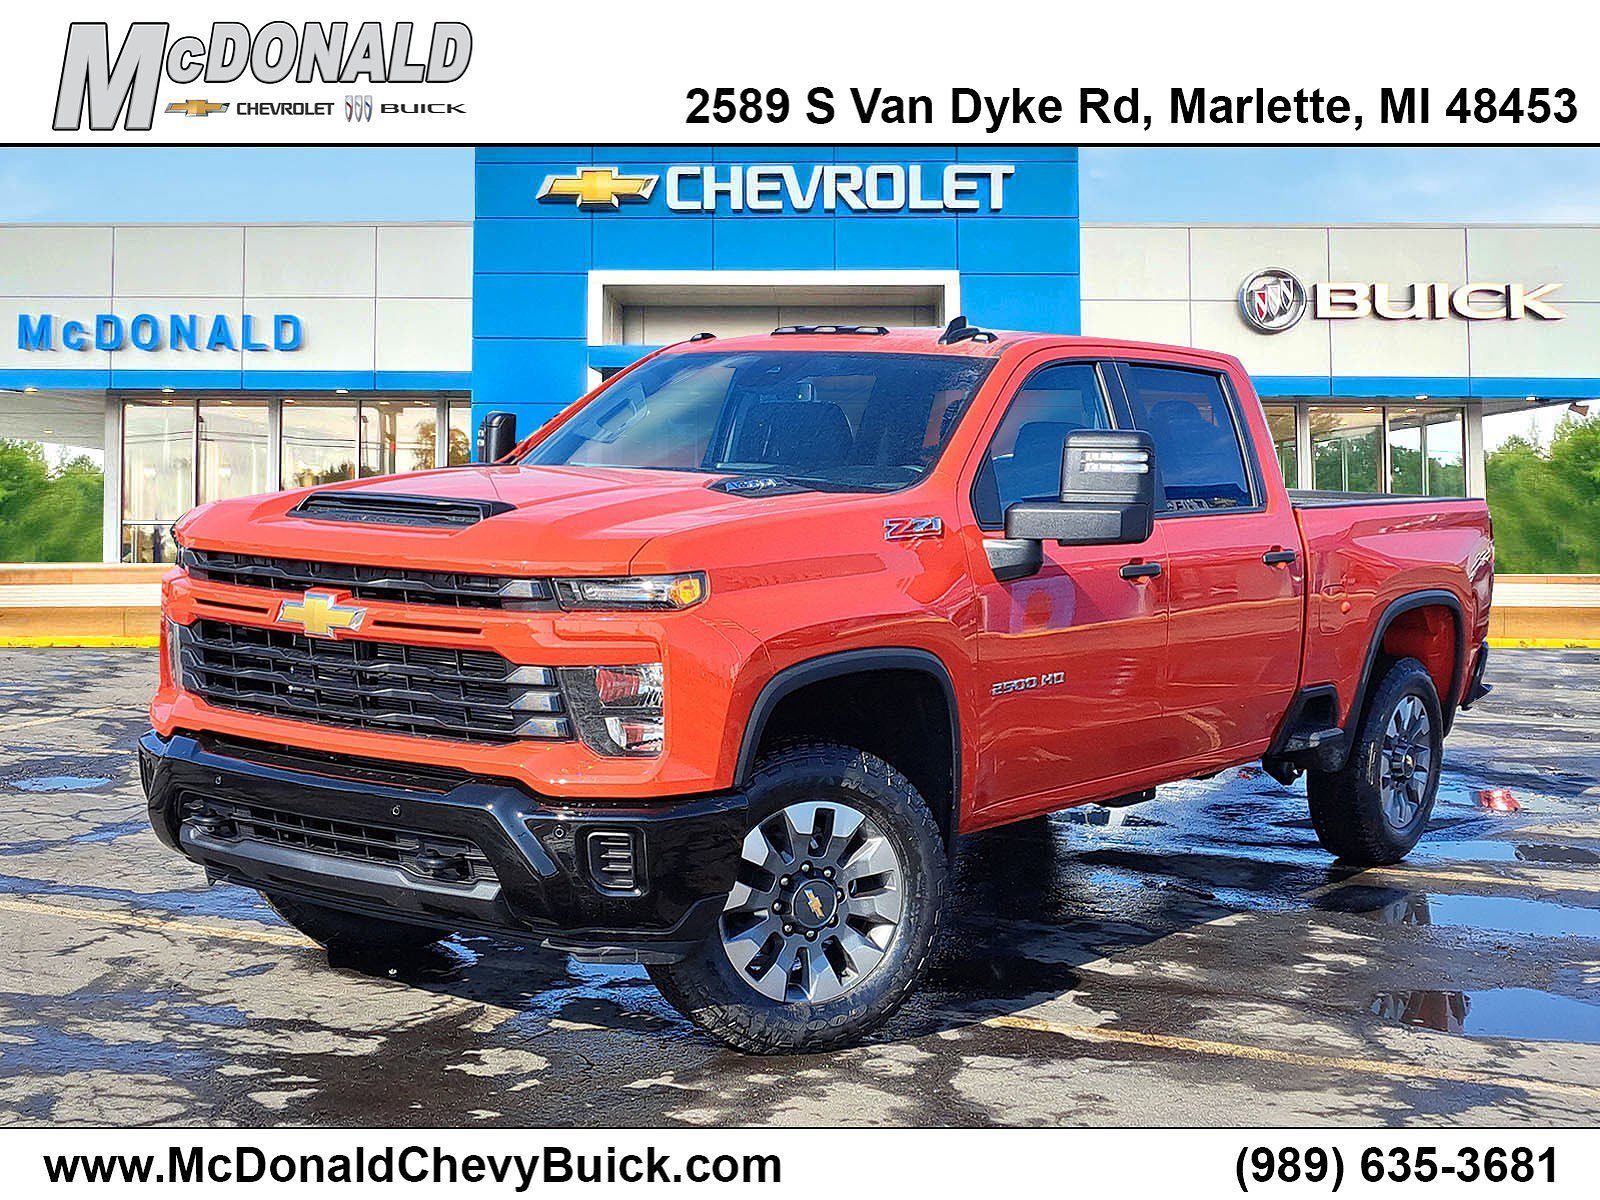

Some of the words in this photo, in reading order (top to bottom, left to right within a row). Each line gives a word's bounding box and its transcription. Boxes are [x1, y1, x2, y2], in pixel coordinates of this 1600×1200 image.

[666, 164, 1016, 212] CHEVROLET
[1313, 282, 1568, 321] BUICK
[18, 313, 304, 352] McDONALD
[991, 676, 1038, 696] 2500
[1041, 671, 1065, 687] HD
